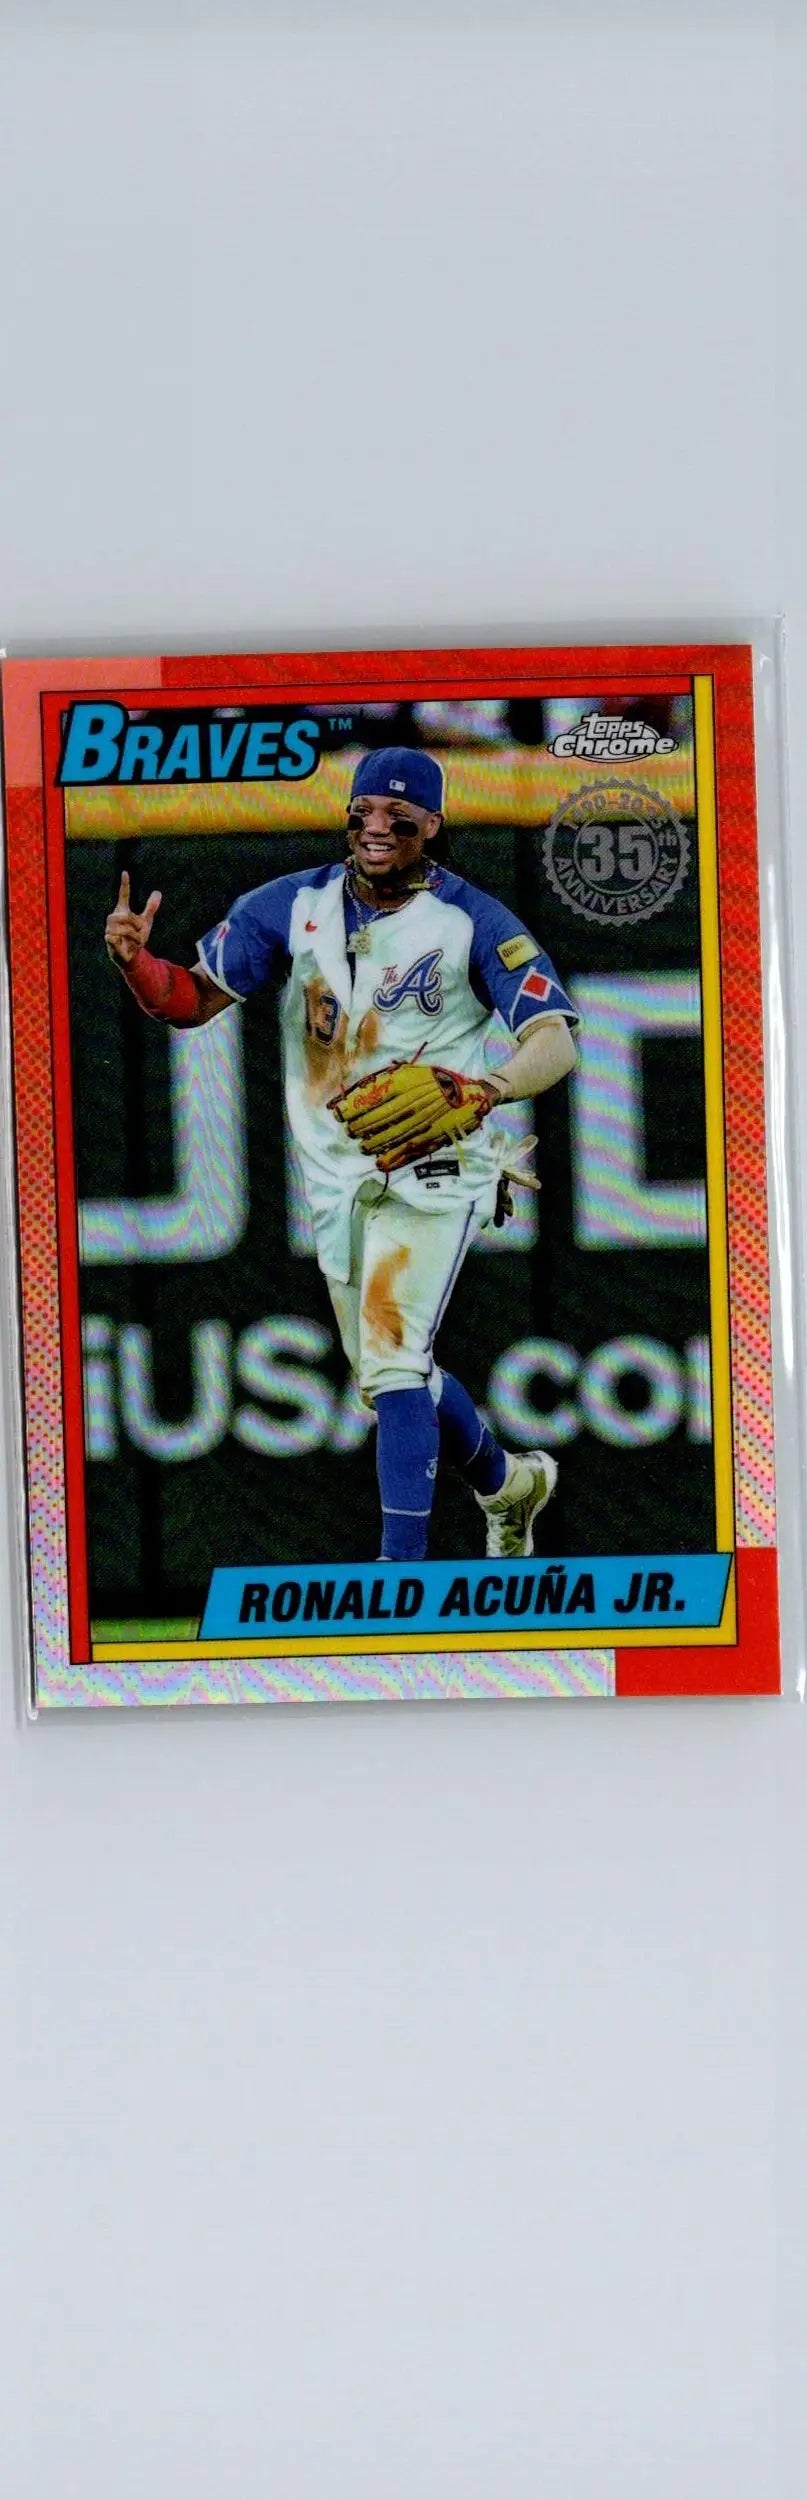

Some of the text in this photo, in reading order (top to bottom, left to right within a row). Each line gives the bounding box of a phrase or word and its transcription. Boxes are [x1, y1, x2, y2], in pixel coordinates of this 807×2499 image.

[59, 702, 321, 783] BRAVES
[553, 732, 674, 758] Chrome
[554, 852, 678, 915] ANNIVERSARY
[373, 949, 444, 1017] A
[238, 1565, 686, 1623] RONALD ACUÑA JR.
